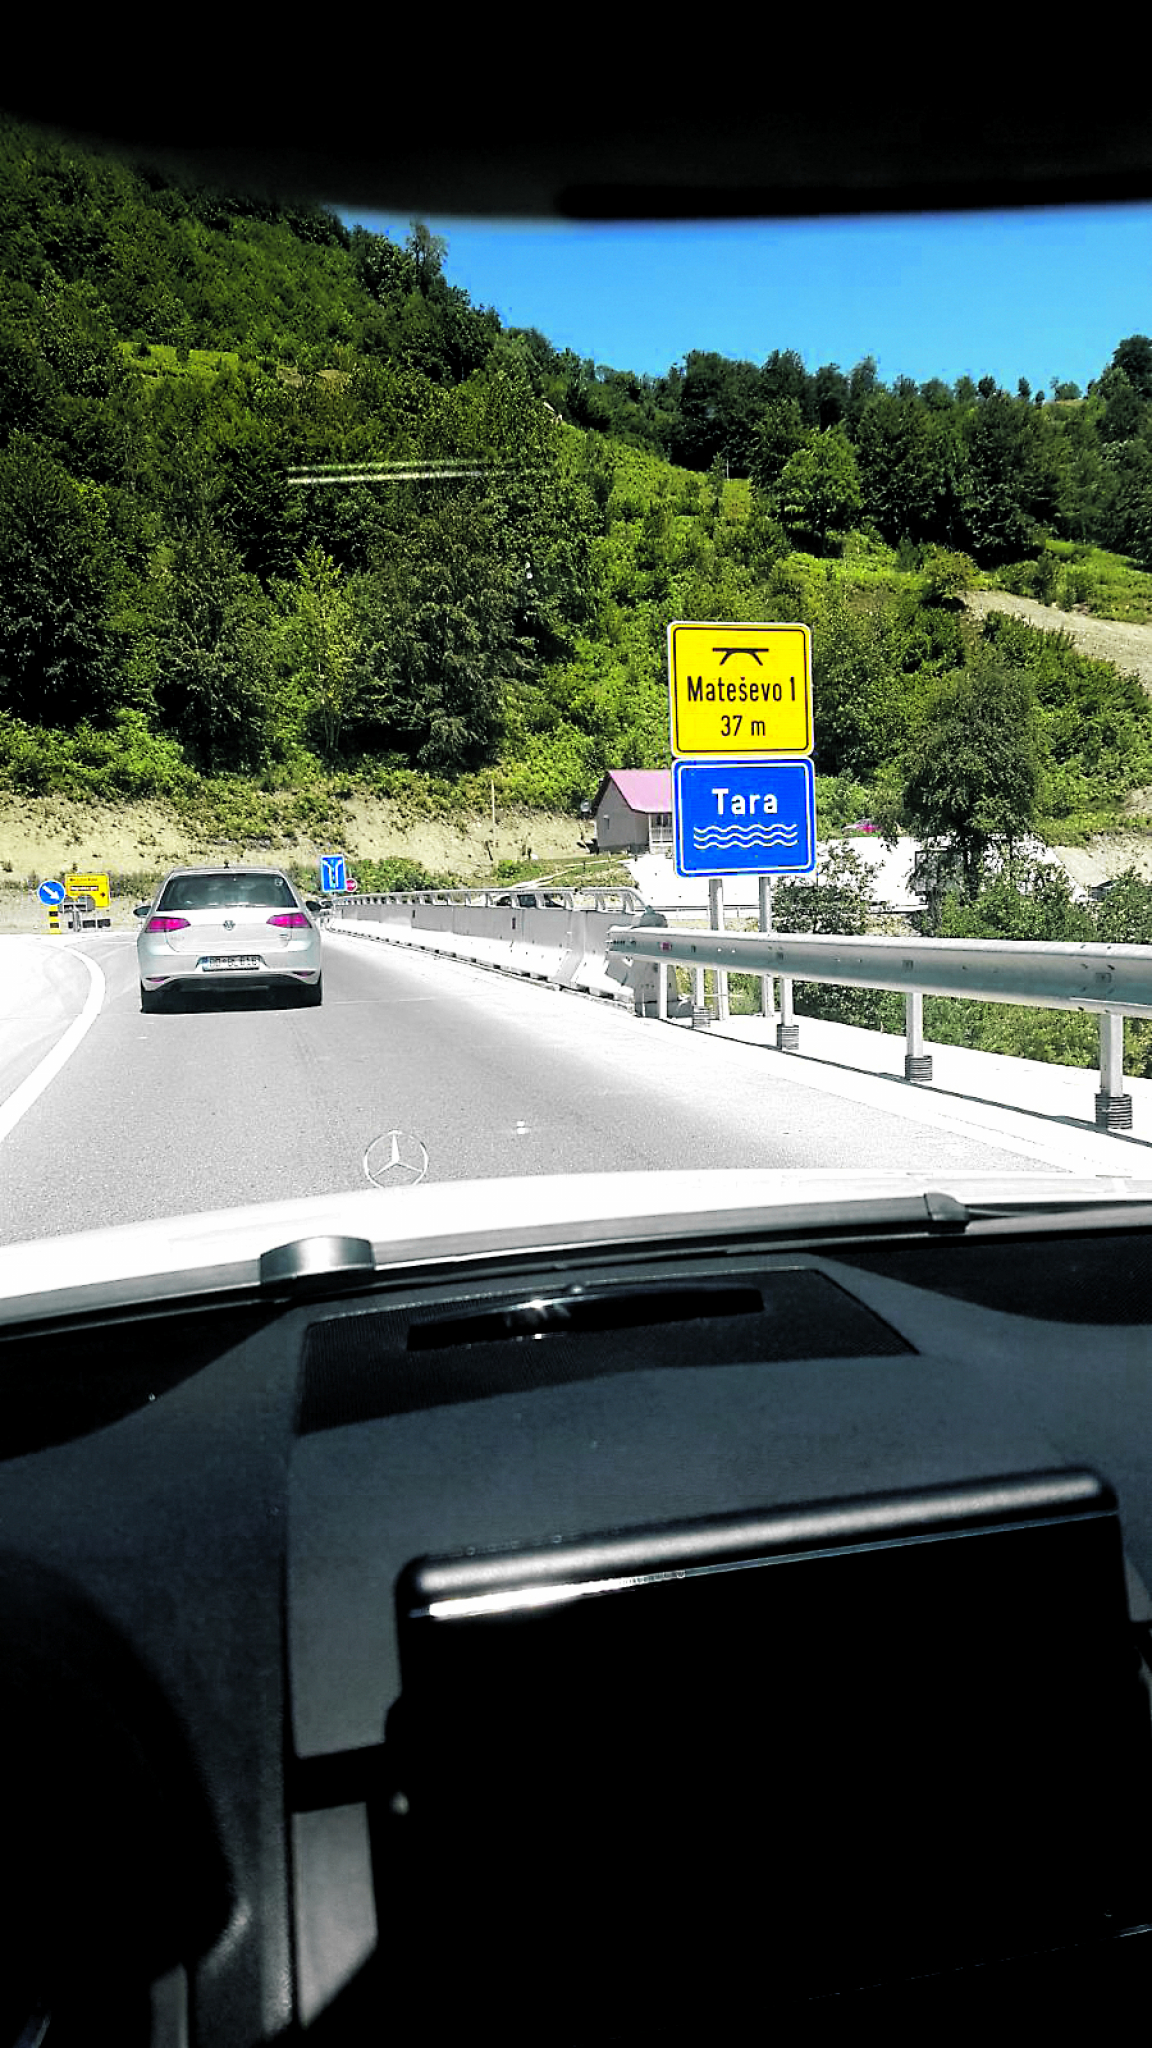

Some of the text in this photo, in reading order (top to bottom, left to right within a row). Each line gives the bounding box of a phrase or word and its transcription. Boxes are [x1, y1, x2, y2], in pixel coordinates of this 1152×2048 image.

[687, 676, 796, 702] Mateševo 1
[720, 715, 766, 737] 37 m
[711, 788, 778, 815] Tara
